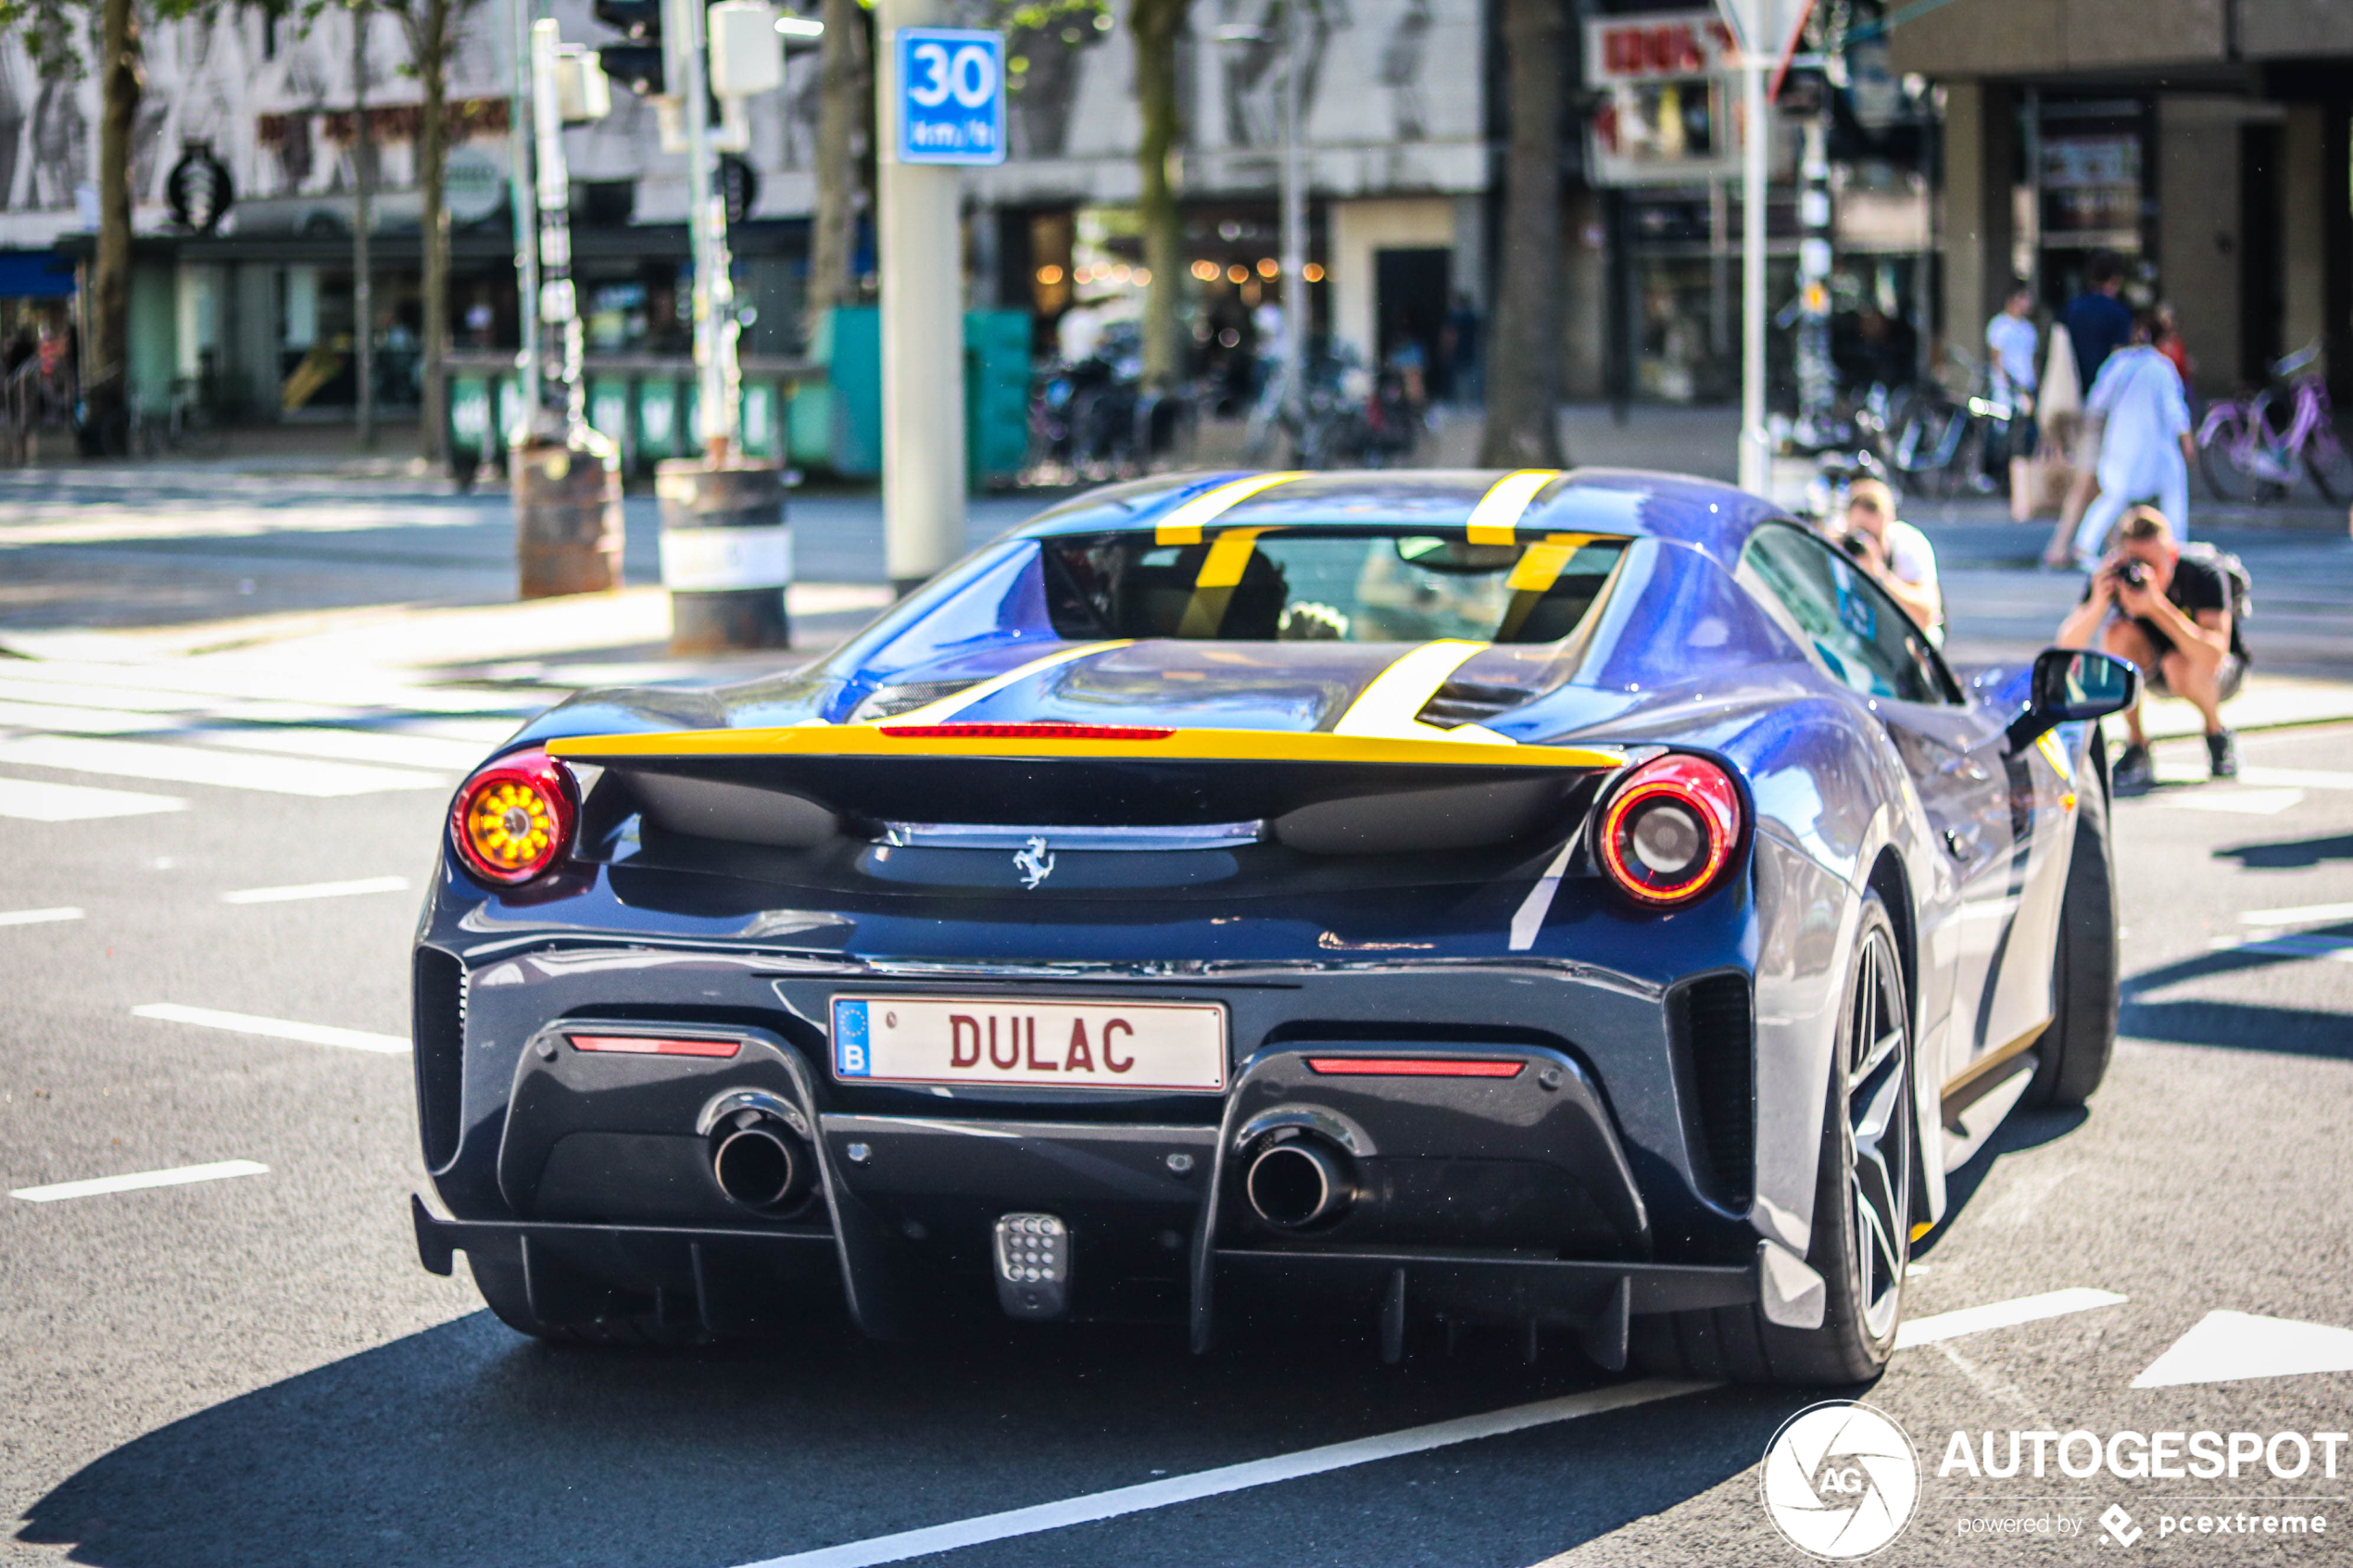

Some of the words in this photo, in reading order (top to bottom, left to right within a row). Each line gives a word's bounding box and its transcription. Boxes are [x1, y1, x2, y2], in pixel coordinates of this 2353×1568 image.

[912, 43, 995, 108] 30
[844, 1045, 865, 1071] B
[950, 1015, 1135, 1073] DULAC
